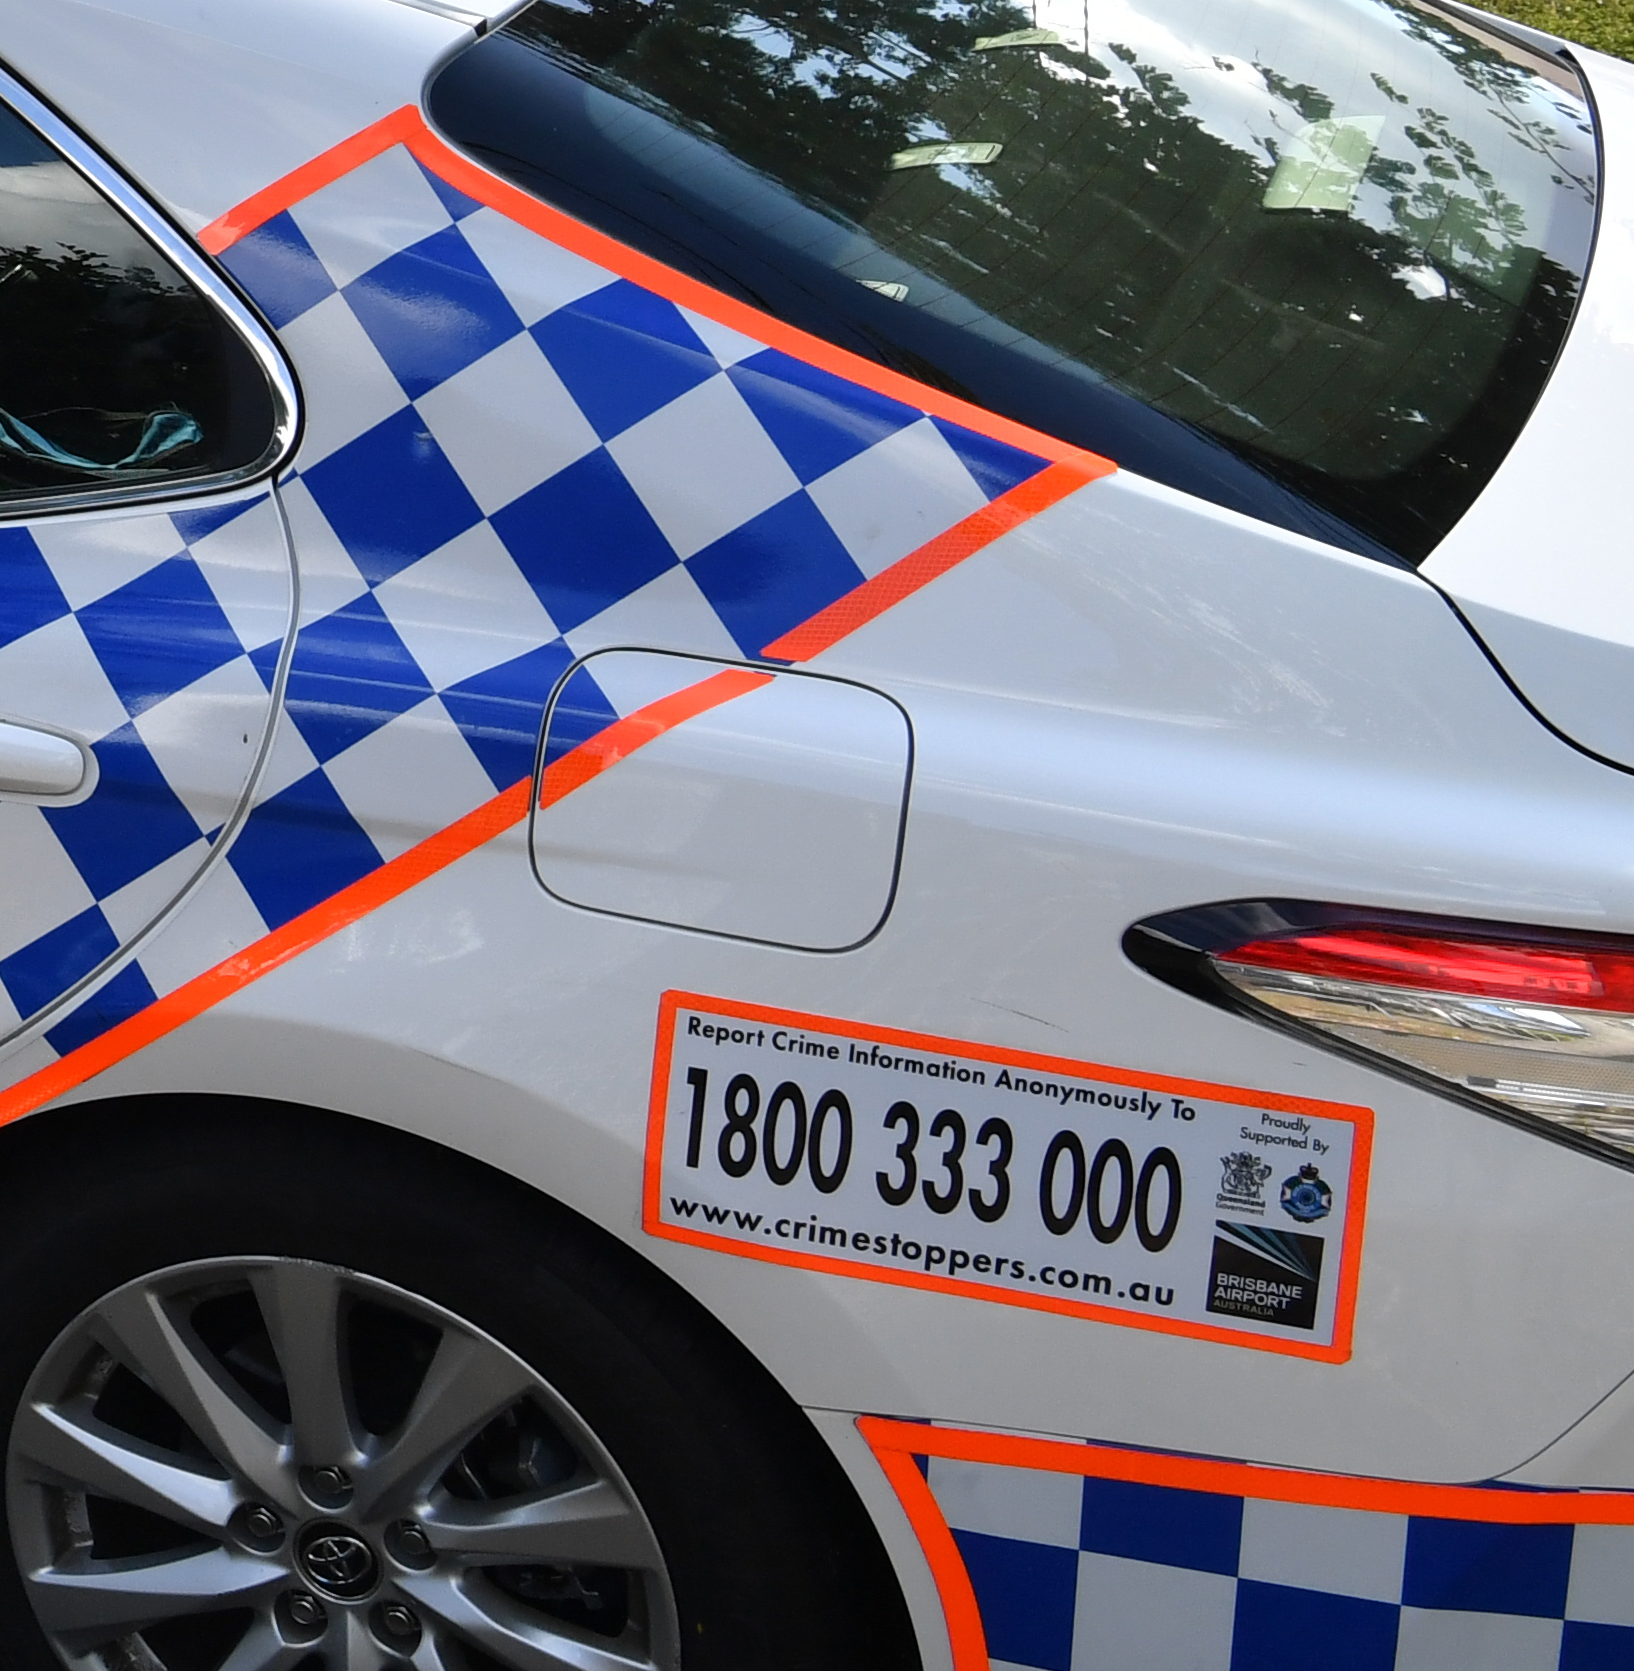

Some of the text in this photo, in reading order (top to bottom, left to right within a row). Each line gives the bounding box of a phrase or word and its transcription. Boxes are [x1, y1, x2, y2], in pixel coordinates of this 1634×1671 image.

[687, 1016, 1196, 1121] Report Crime Information Anonymously To
[1261, 1113, 1311, 1135] Proudly
[1239, 1127, 1330, 1155] Supported By
[686, 1066, 1182, 1253] 1800 333 000
[1215, 1201, 1265, 1216] Government
[1216, 1193, 1266, 1208] Queensland
[669, 1197, 1174, 1306] www.crimestoppers.com.au
[1214, 1287, 1291, 1309] AIRPORT
[1217, 1272, 1303, 1300] BRISBANE
[1213, 1299, 1275, 1316] AUSTRALIA
